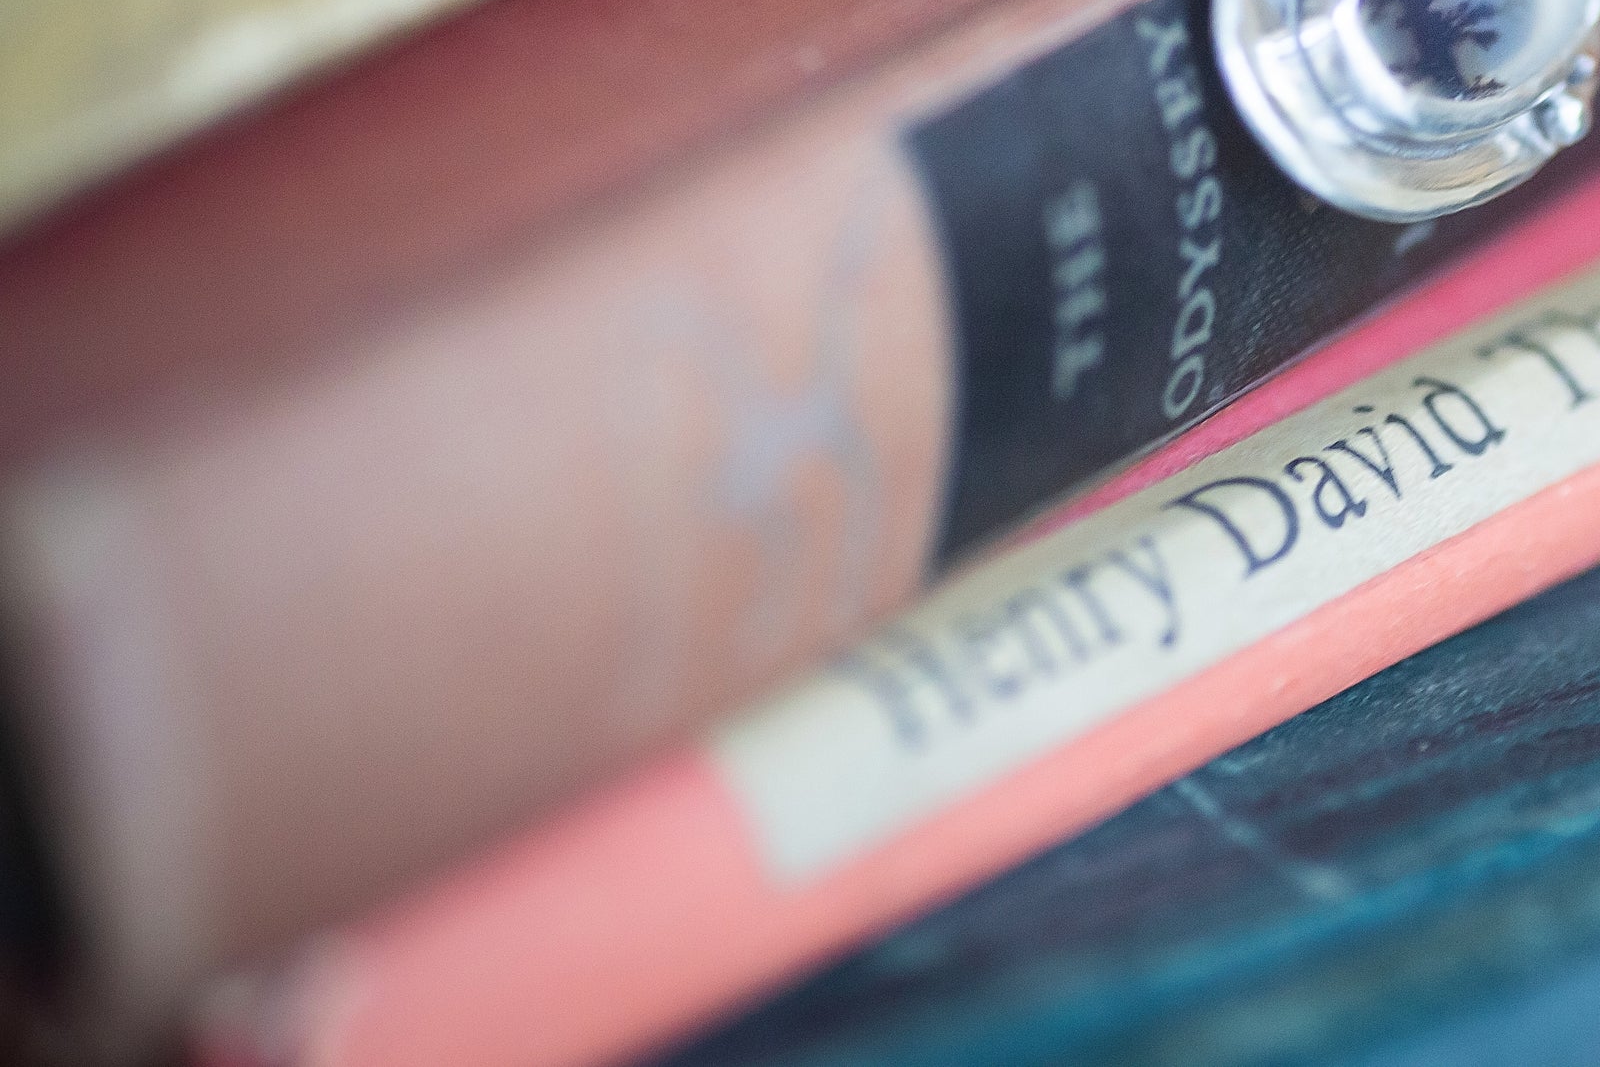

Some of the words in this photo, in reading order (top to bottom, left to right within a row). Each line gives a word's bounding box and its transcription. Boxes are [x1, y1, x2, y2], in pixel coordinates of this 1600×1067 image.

[1044, 177, 1107, 402] THE
[1132, 12, 1224, 422] ODYSSEY
[832, 534, 1183, 754] Henry
[1167, 374, 1506, 581] David
